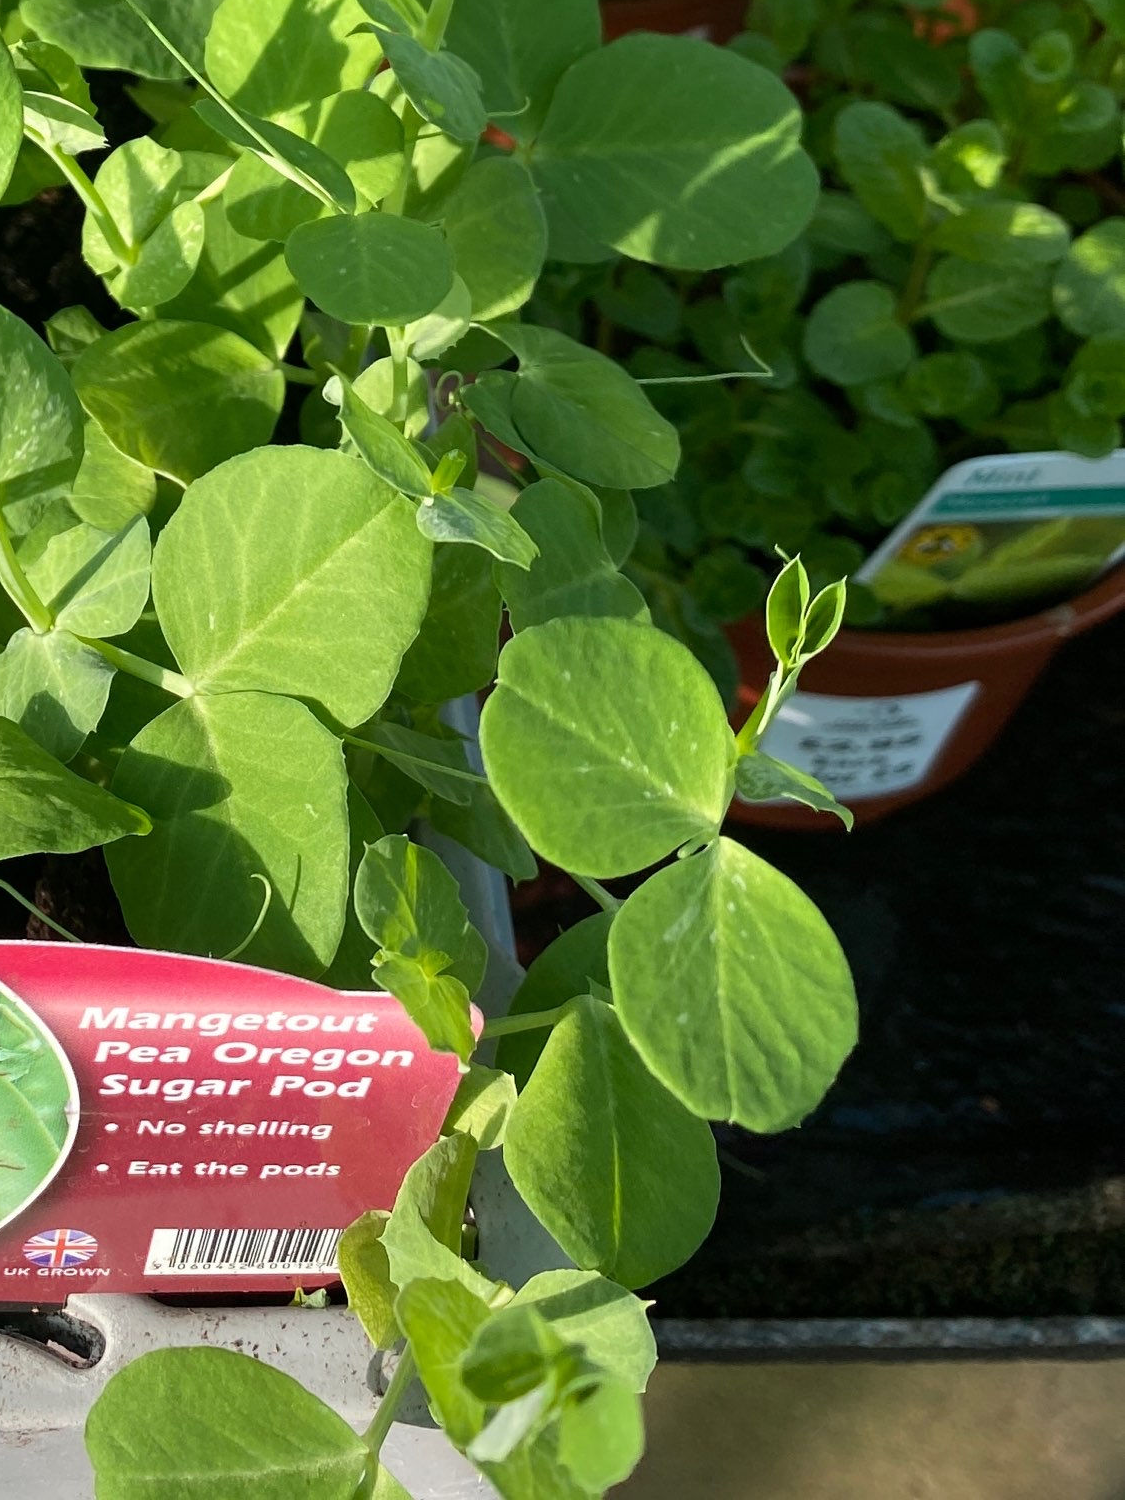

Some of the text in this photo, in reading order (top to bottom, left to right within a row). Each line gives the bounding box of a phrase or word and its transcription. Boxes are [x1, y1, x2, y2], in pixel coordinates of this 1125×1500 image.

[79, 1007, 378, 1036] Mangetout
[94, 1042, 415, 1072] Pea Oregon
[99, 1074, 373, 1101] Sugar Pod
[137, 1119, 334, 1141] No shelling
[127, 1161, 341, 1179] Eat the pods
[4, 1267, 112, 1277] UK GROWN
